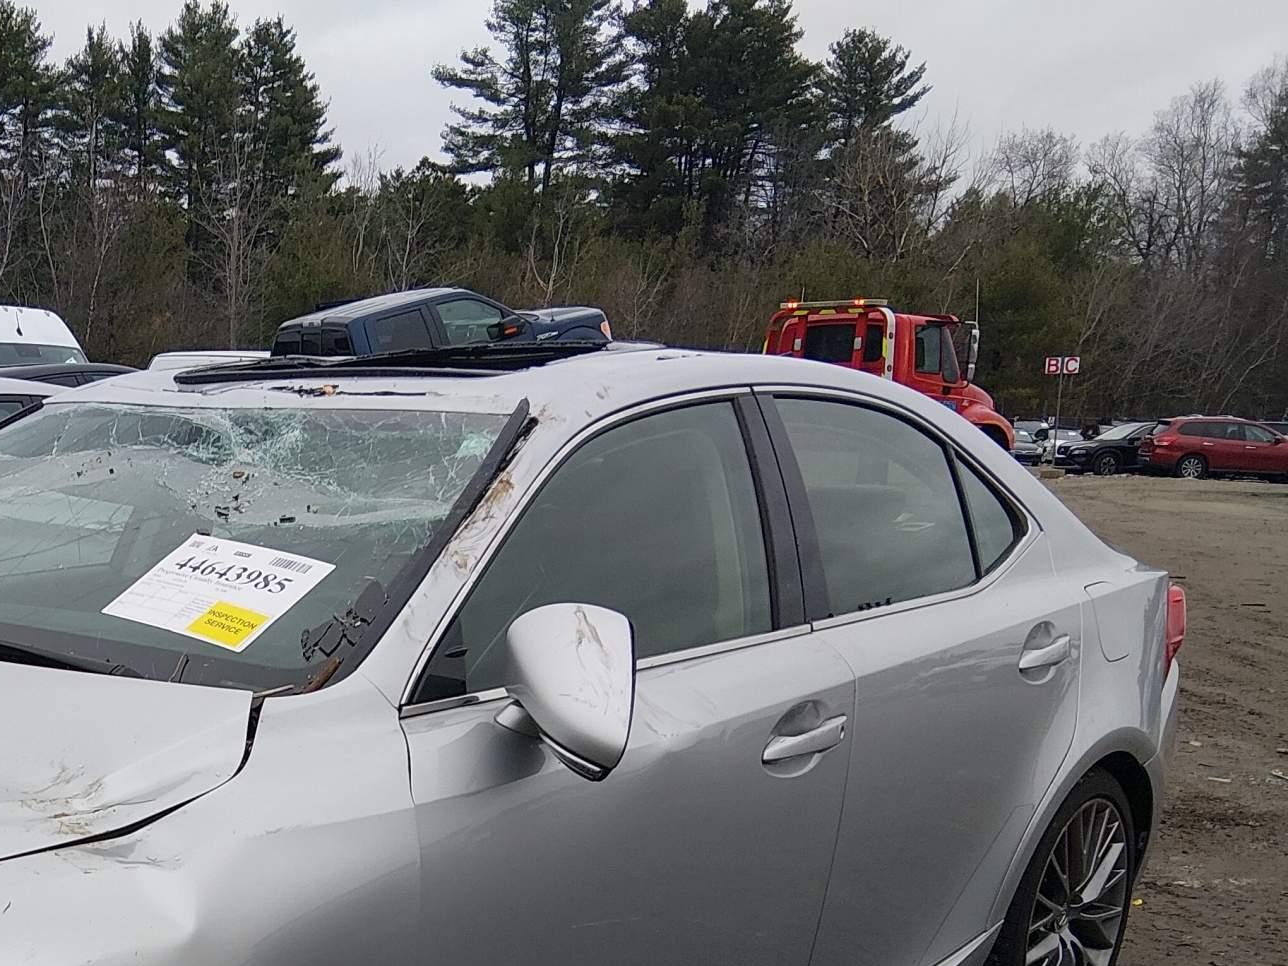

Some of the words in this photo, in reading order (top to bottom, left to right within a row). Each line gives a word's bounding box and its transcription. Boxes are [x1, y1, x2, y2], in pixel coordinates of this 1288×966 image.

[1047, 358, 1060, 373] B
[1065, 357, 1079, 373] C
[175, 556, 294, 594] 44643985
[204, 618, 243, 635] SERVICE
[208, 609, 257, 630] INSPECTION
